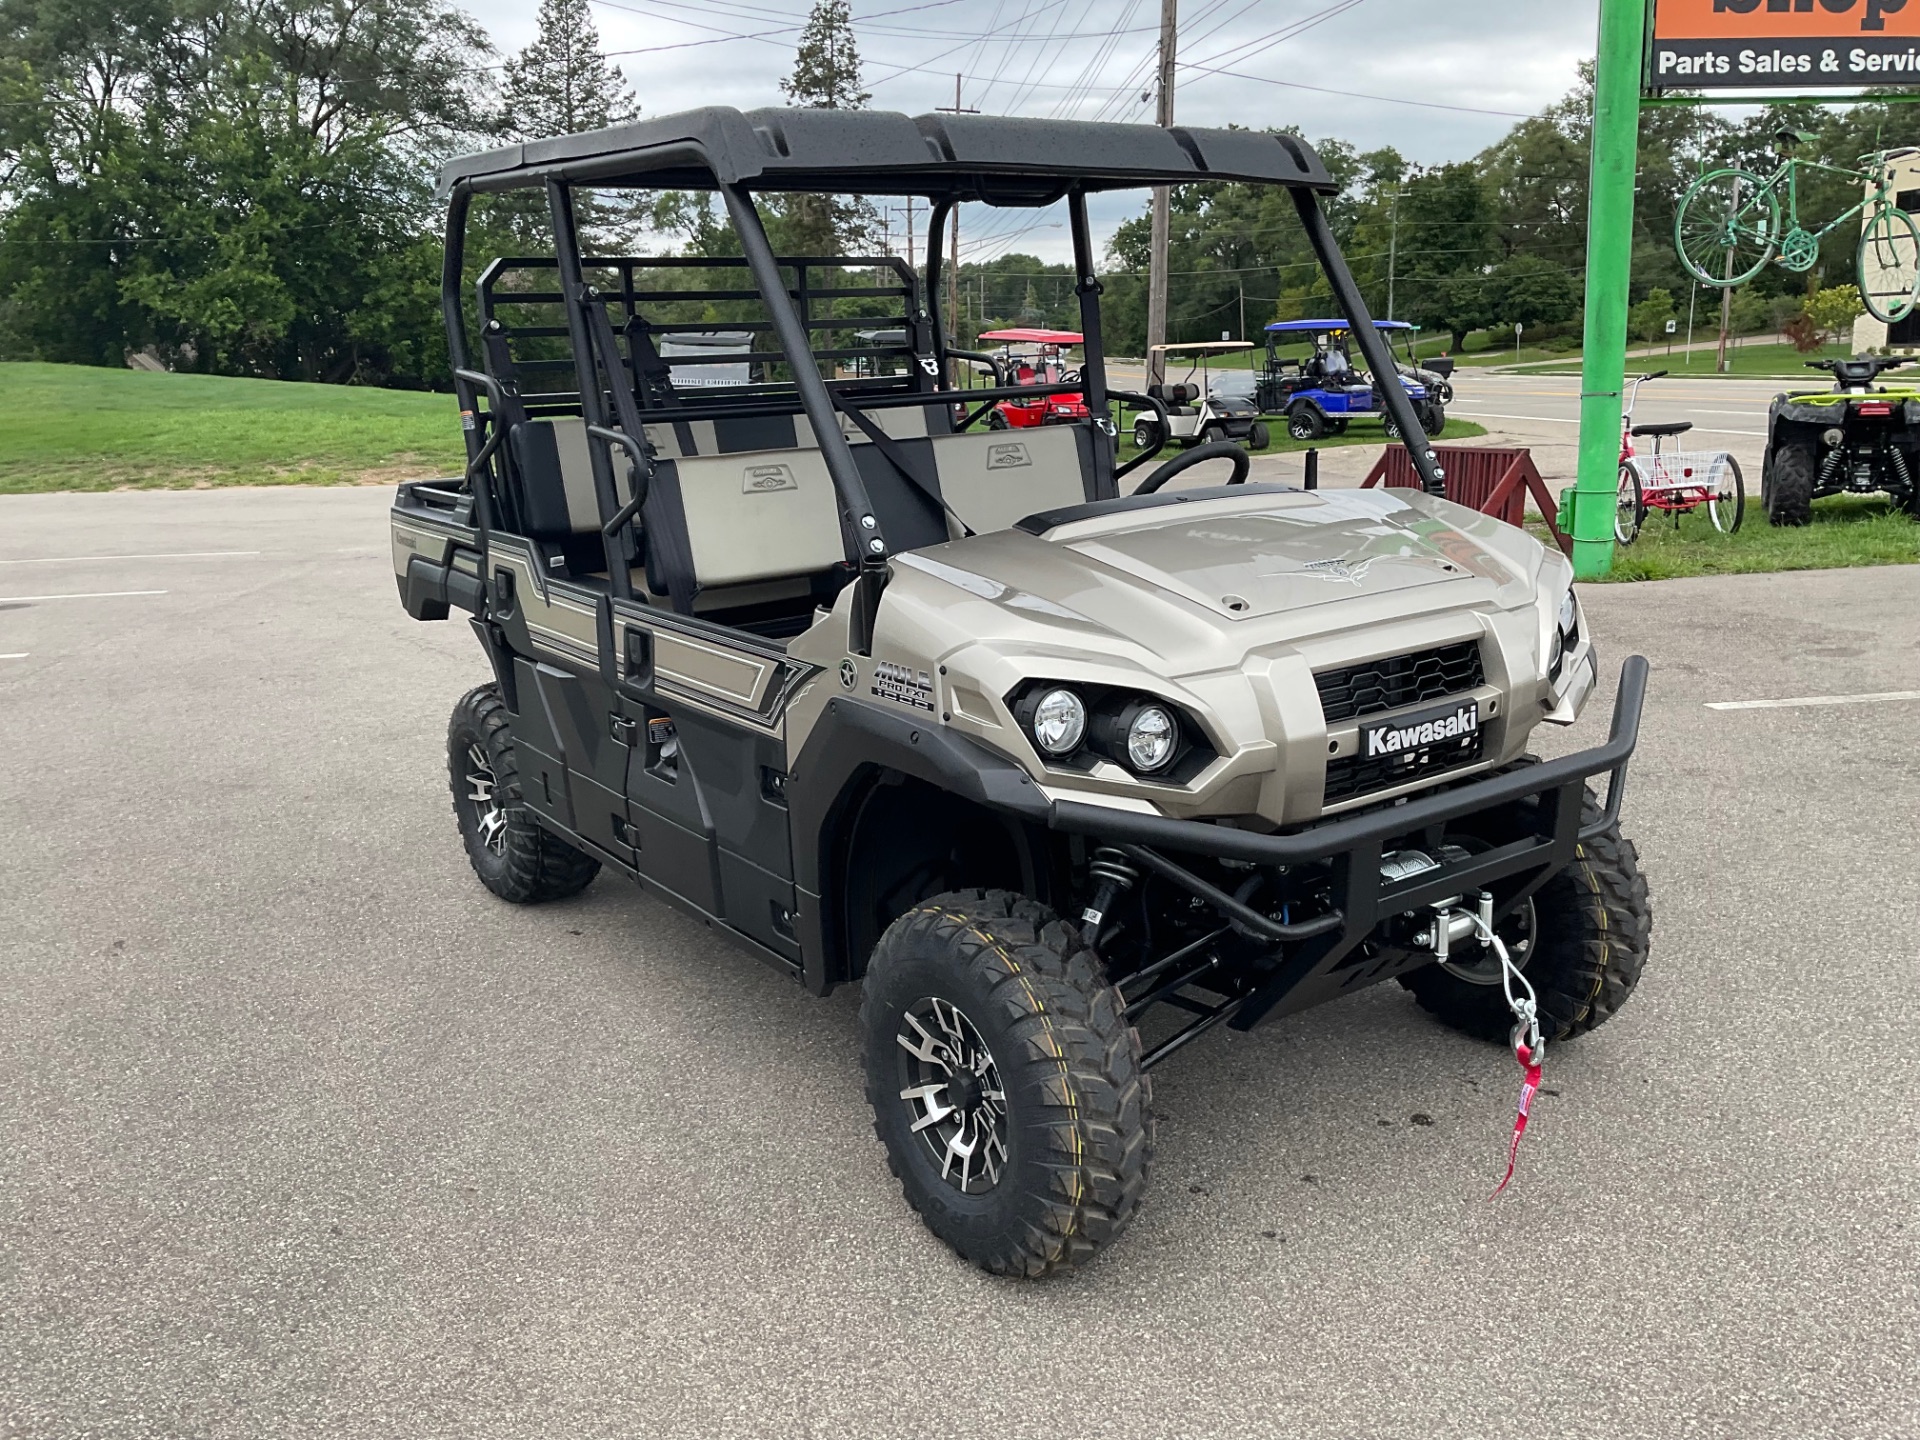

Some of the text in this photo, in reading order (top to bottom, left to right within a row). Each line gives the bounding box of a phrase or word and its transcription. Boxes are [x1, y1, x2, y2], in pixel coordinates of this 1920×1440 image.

[1659, 48, 1920, 74] Parts Sales & Servi
[874, 661, 933, 692] MULE
[878, 680, 926, 699] PRO FXT
[1368, 705, 1477, 756] Kawasaki
